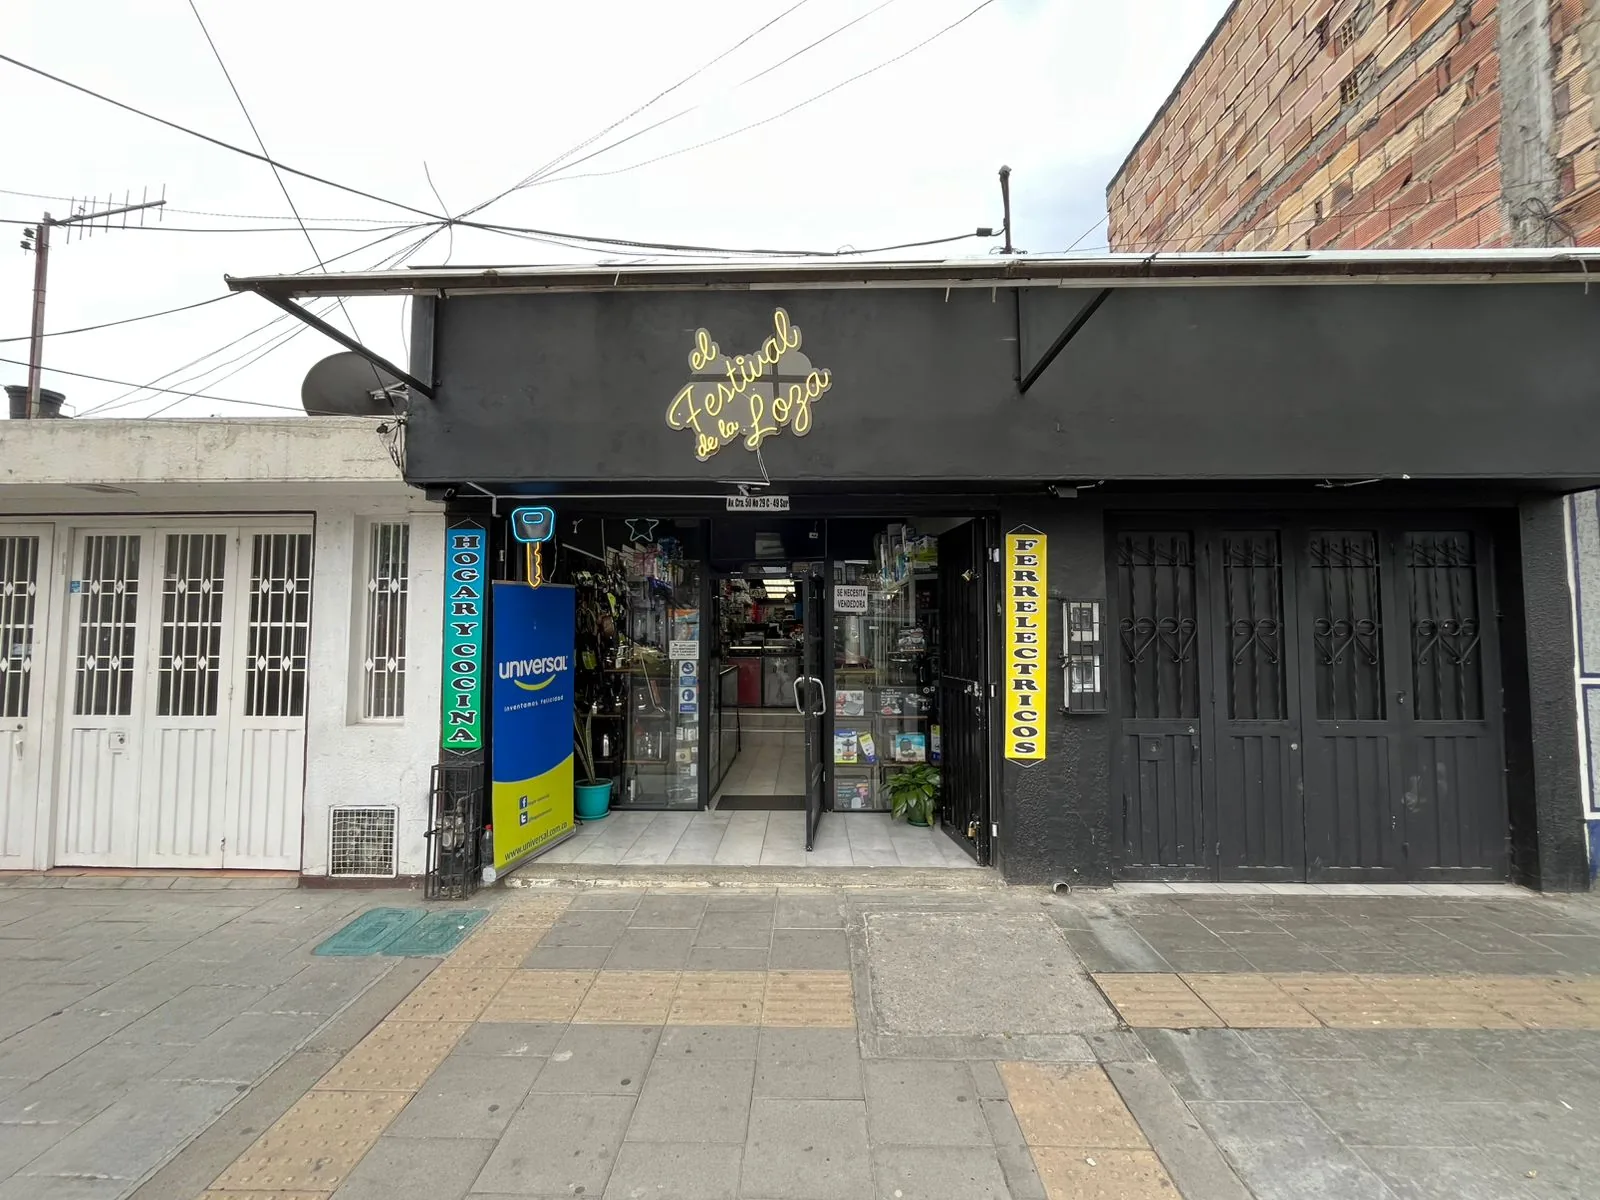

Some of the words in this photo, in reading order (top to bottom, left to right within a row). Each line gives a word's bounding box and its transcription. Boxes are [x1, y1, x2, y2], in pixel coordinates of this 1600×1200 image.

[692, 331, 715, 370] el
[669, 311, 797, 432] Festival
[698, 434, 718, 457] de
[718, 419, 738, 438] la
[747, 371, 829, 446] Loza
[450, 534, 480, 615] HOGAR
[837, 588, 843, 597] SE
[844, 588, 866, 597] NECESITA
[837, 600, 866, 608] VENDEDORA
[450, 622, 478, 636] Y
[1012, 538, 1039, 754] FERRELECTRICOS
[498, 656, 568, 679] universal
[449, 643, 477, 742] COCINA
[504, 821, 568, 861] www.universal.com.co
